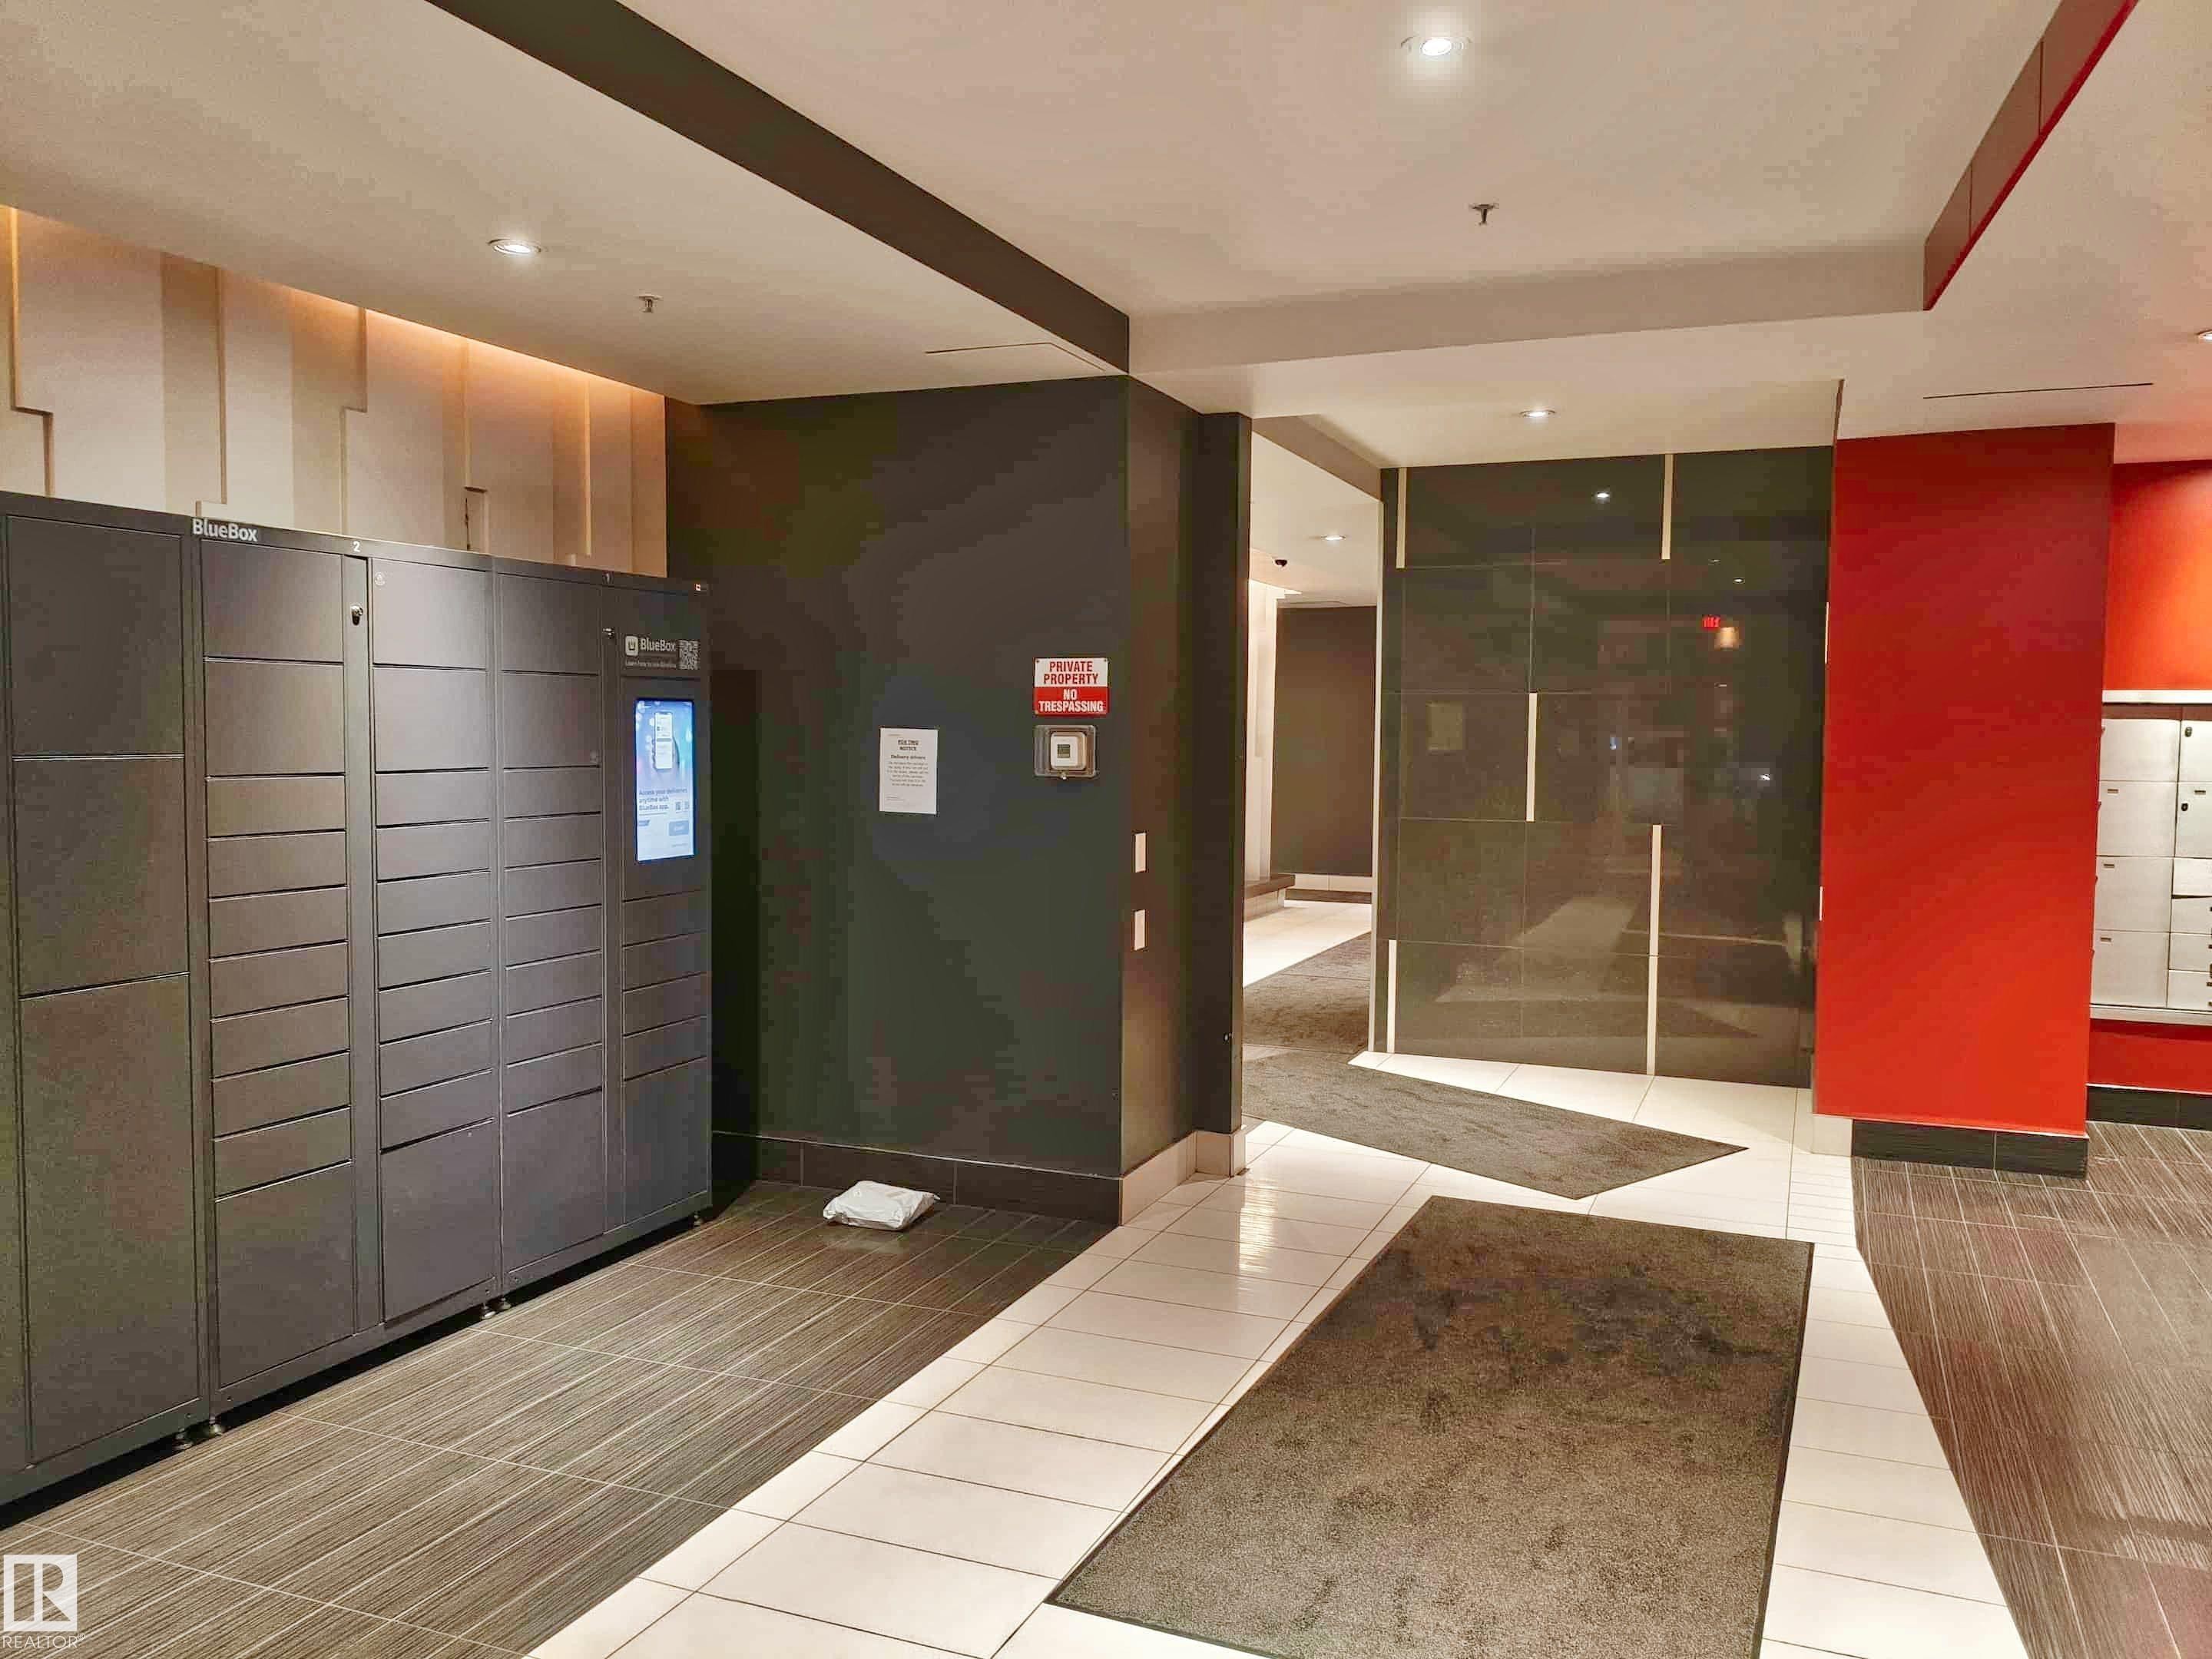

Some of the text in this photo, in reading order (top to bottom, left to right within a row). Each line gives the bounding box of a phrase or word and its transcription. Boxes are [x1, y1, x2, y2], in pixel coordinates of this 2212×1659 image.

[192, 517, 258, 542] BlueBox
[352, 541, 361, 552] 2
[640, 637, 676, 651] BlueBox
[1049, 661, 1093, 672] PRIVATE
[1044, 673, 1098, 684] PROPERTY
[1062, 688, 1078, 700] NO
[1038, 700, 1104, 714] TRESPASSING
